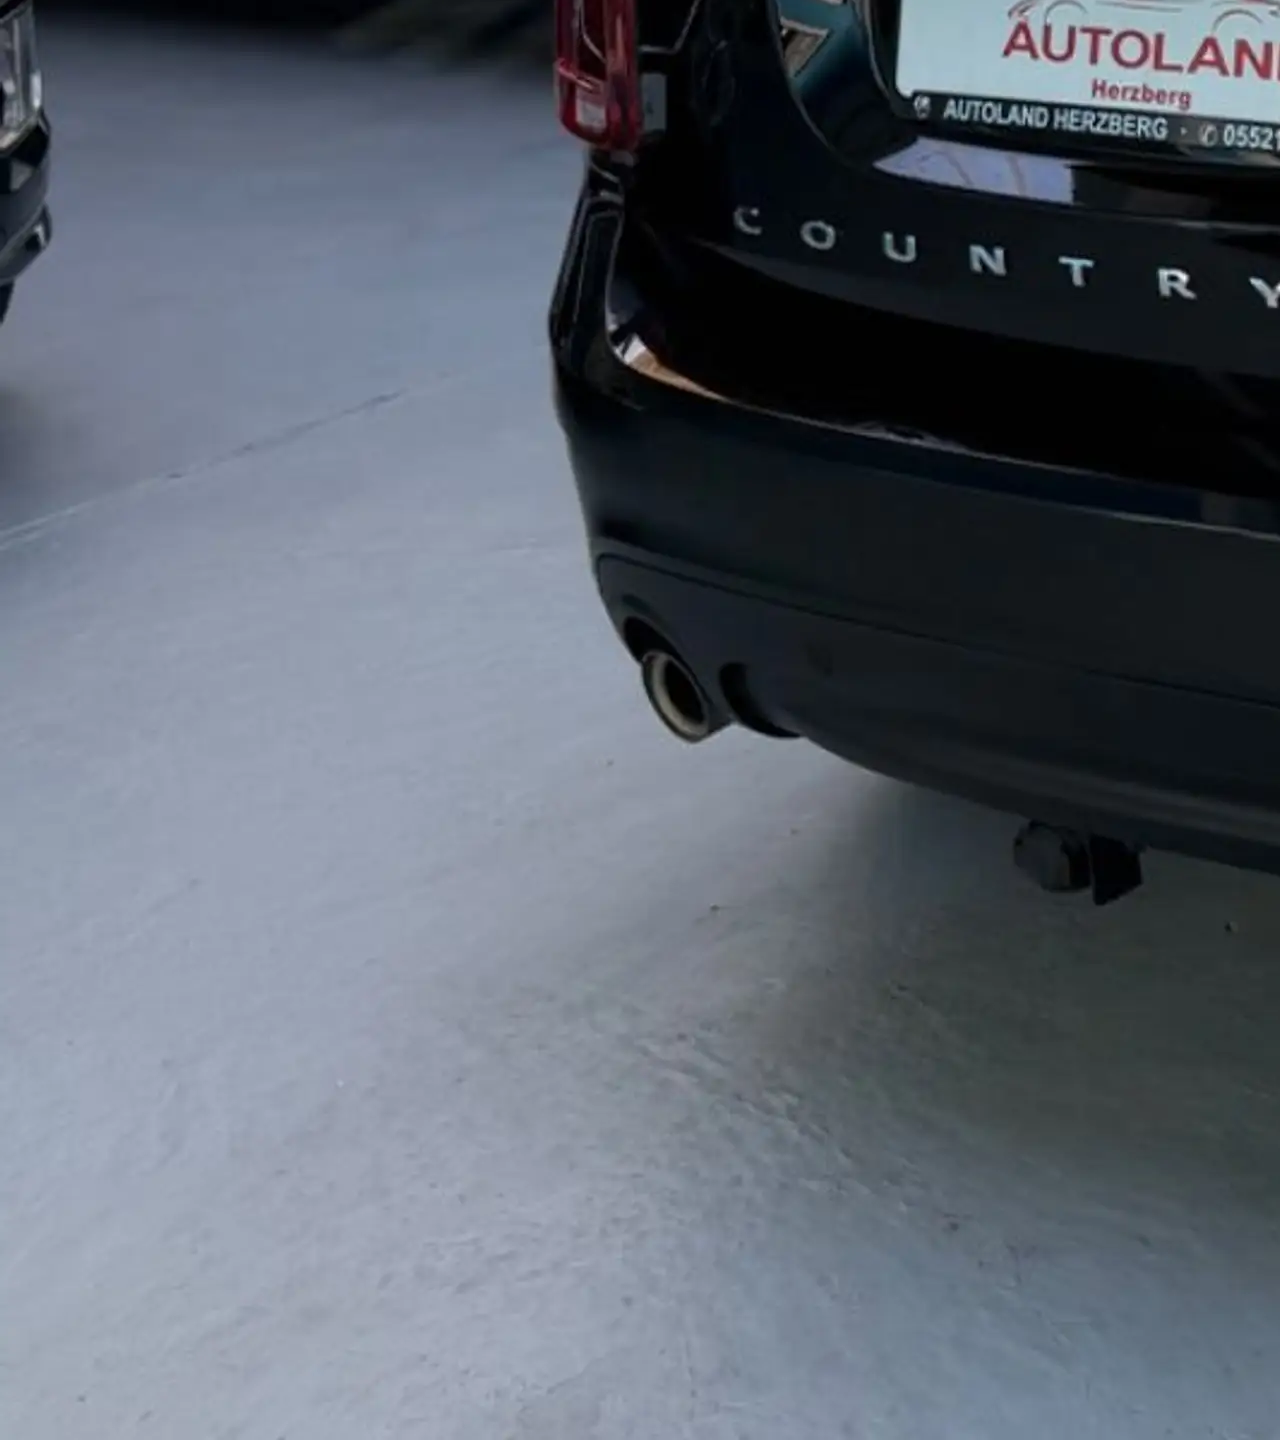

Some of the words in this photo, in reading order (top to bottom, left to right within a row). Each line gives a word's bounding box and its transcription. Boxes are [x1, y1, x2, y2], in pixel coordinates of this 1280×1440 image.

[1092, 78, 1191, 110] Herzberg
[943, 97, 1049, 129] AUTOLAND
[1053, 107, 1169, 141] HERZBERG
